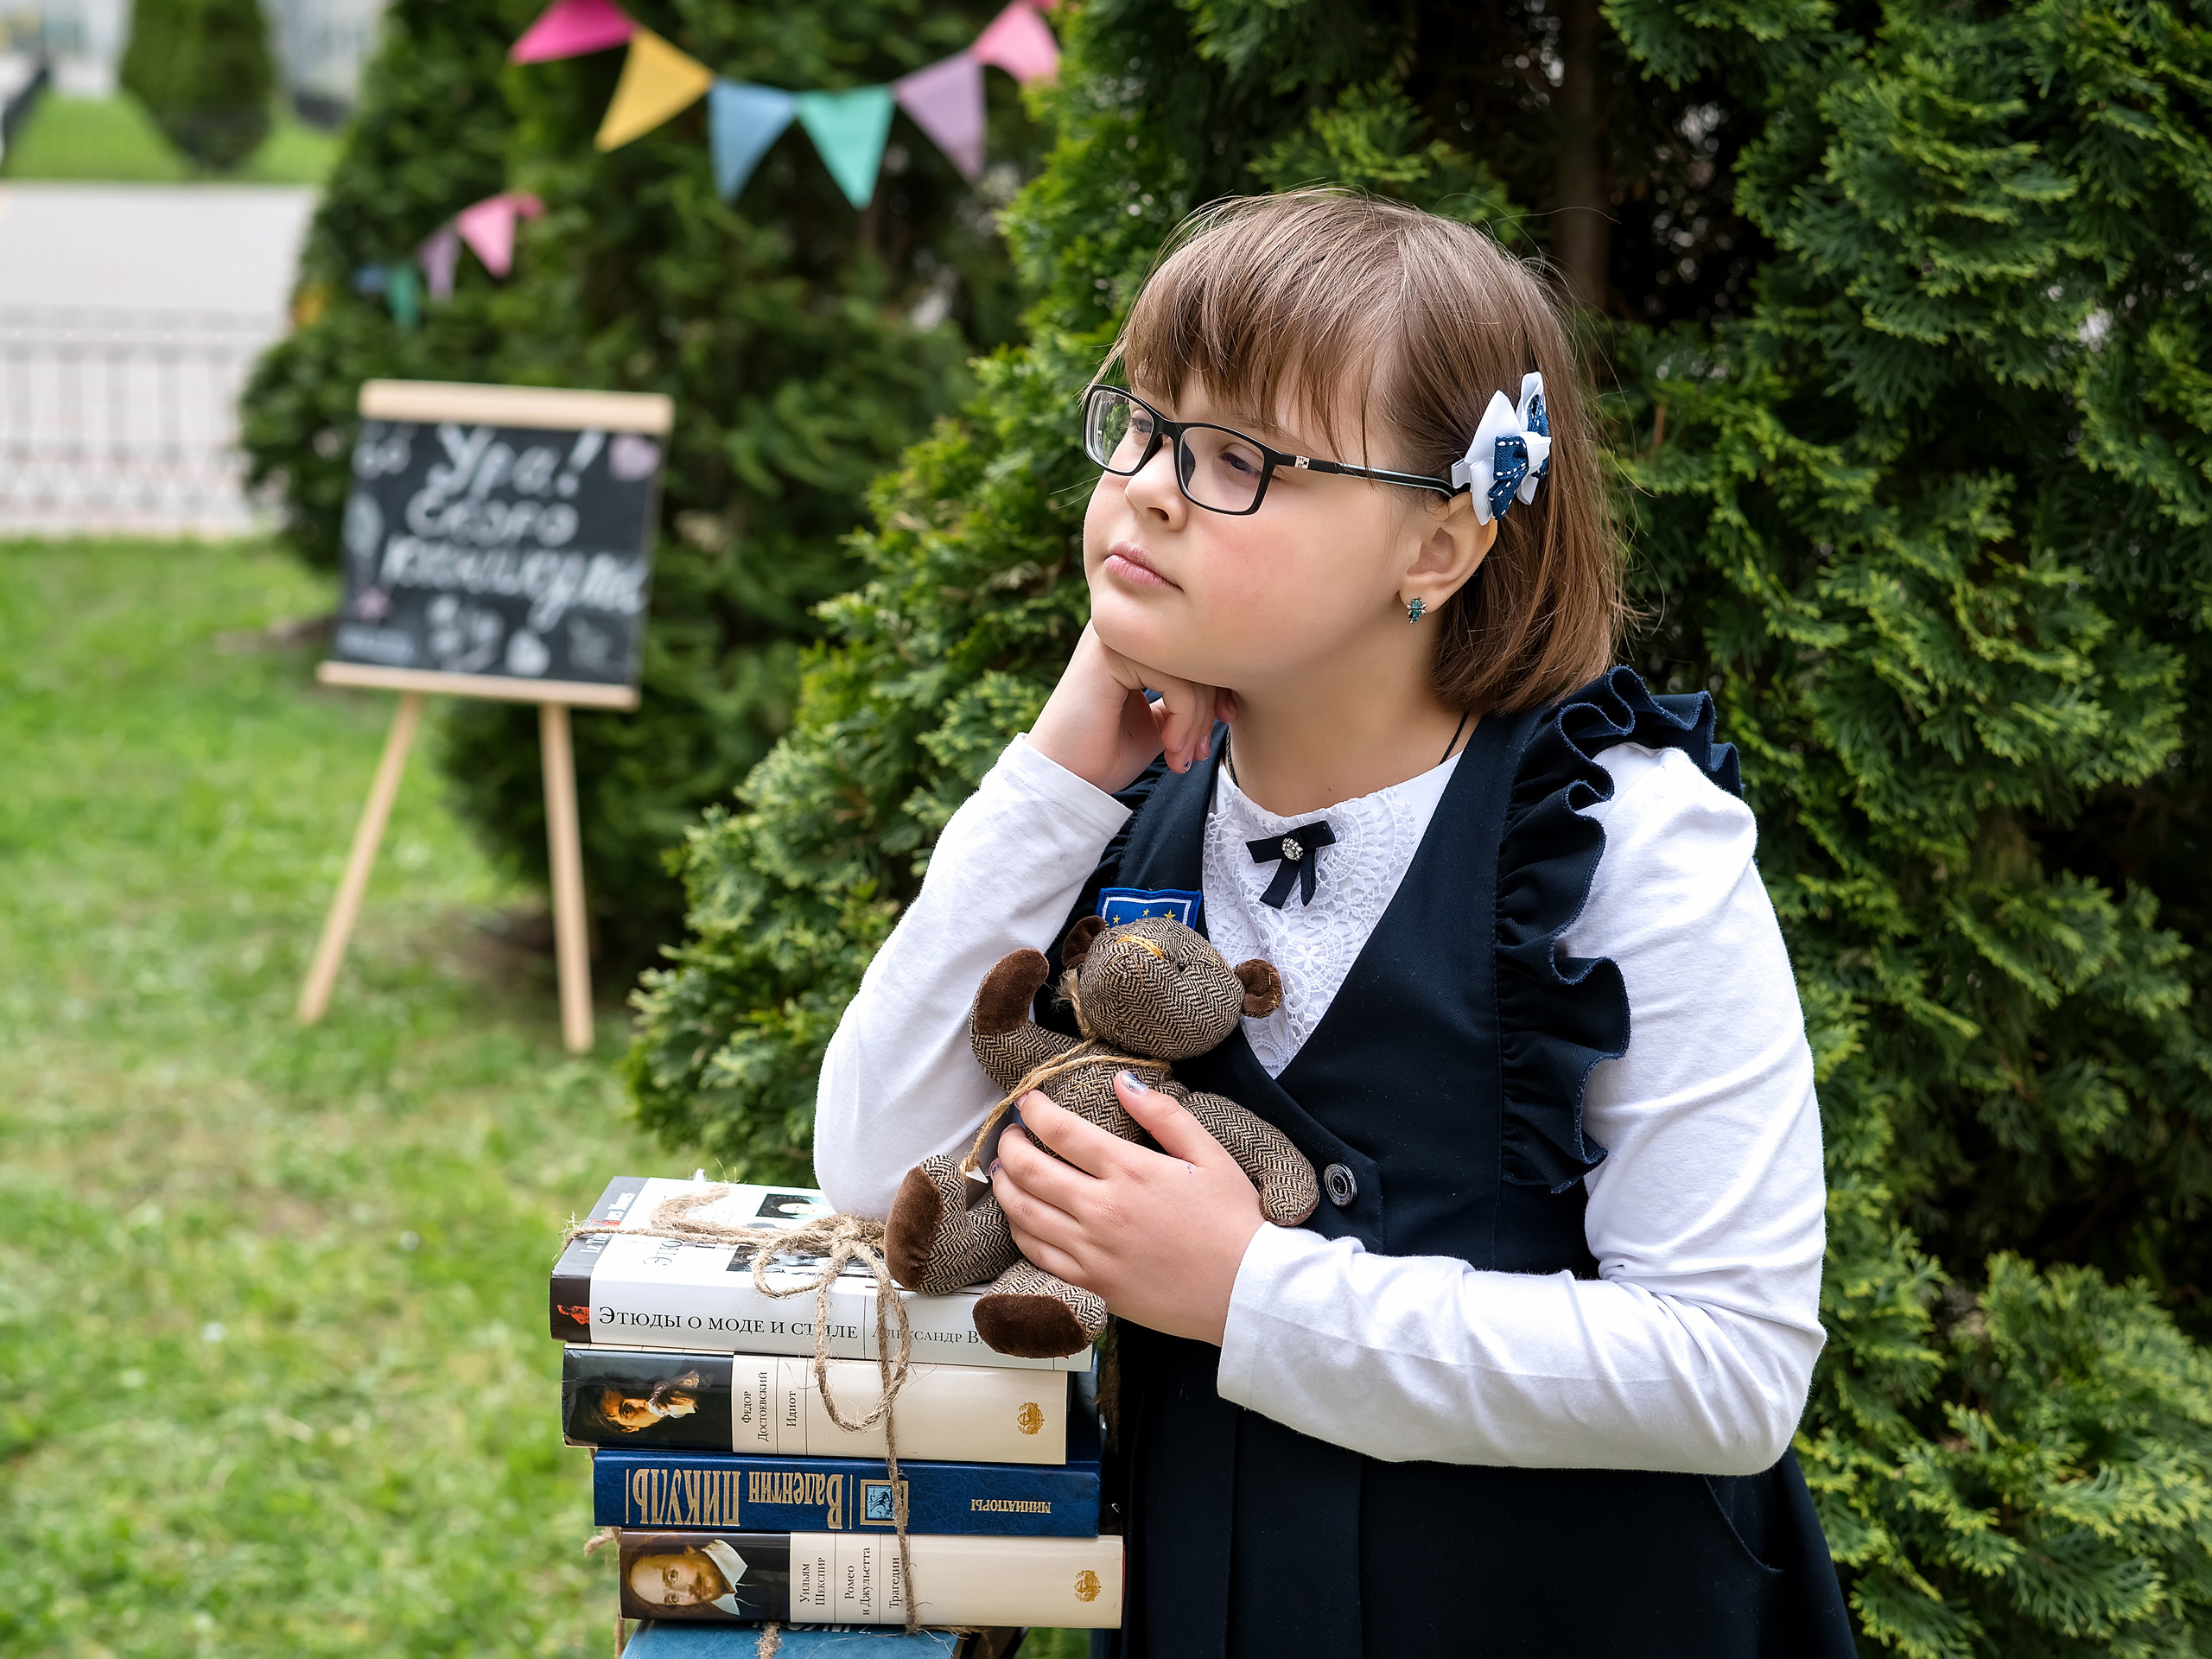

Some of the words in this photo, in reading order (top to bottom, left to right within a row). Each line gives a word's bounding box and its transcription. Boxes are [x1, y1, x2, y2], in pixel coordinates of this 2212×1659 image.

[632, 1469, 741, 1526] ПИКУЛЬ
[970, 1498, 1052, 1514] МИНИАТЮРЫ
[844, 1565, 855, 1599] Ромео
[860, 1547, 873, 1607] Джульетта
[888, 1557, 902, 1609] Трагедии
